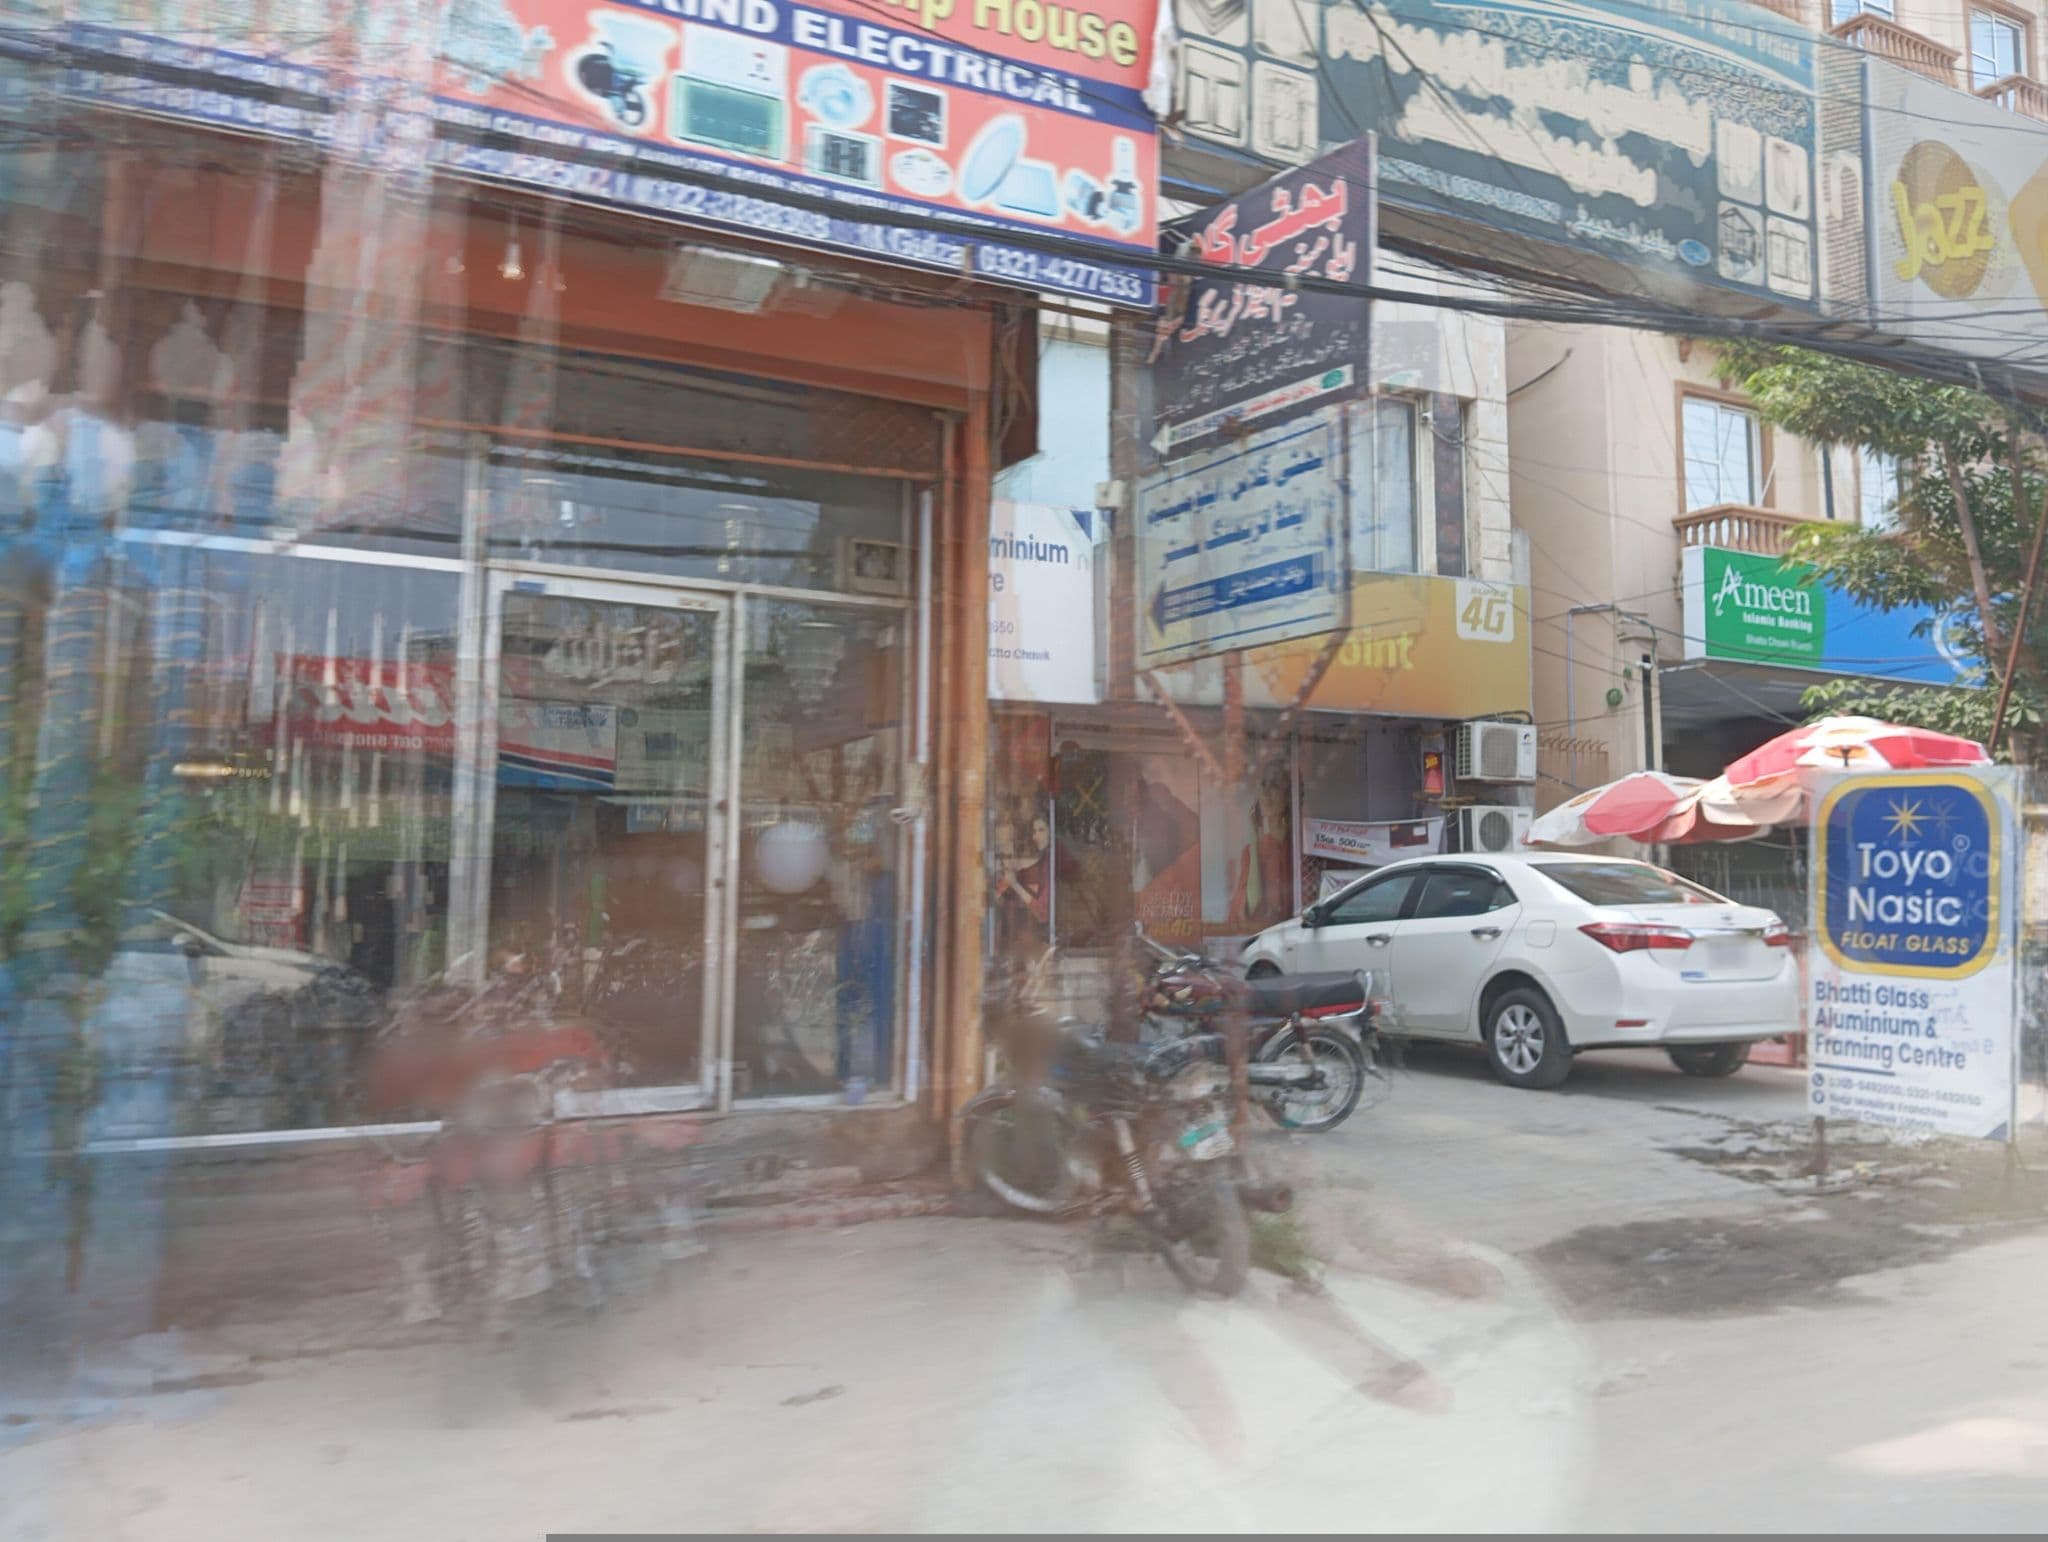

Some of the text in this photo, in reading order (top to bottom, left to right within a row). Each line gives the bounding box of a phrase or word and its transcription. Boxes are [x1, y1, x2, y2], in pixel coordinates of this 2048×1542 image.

[1891, 180, 1996, 281] Jazz
[1712, 562, 1812, 616] Ameen
[1461, 596, 1508, 635] 4G
[1857, 842, 1952, 887] Toyo
[1848, 886, 1962, 926] Nasic
[1840, 931, 1970, 955] FLOAT GLASS
[1815, 980, 1930, 1010] Bhatti Glass
[1815, 1007, 1938, 1039] Aluminium &
[1815, 1033, 1967, 1070] Framing Centre
